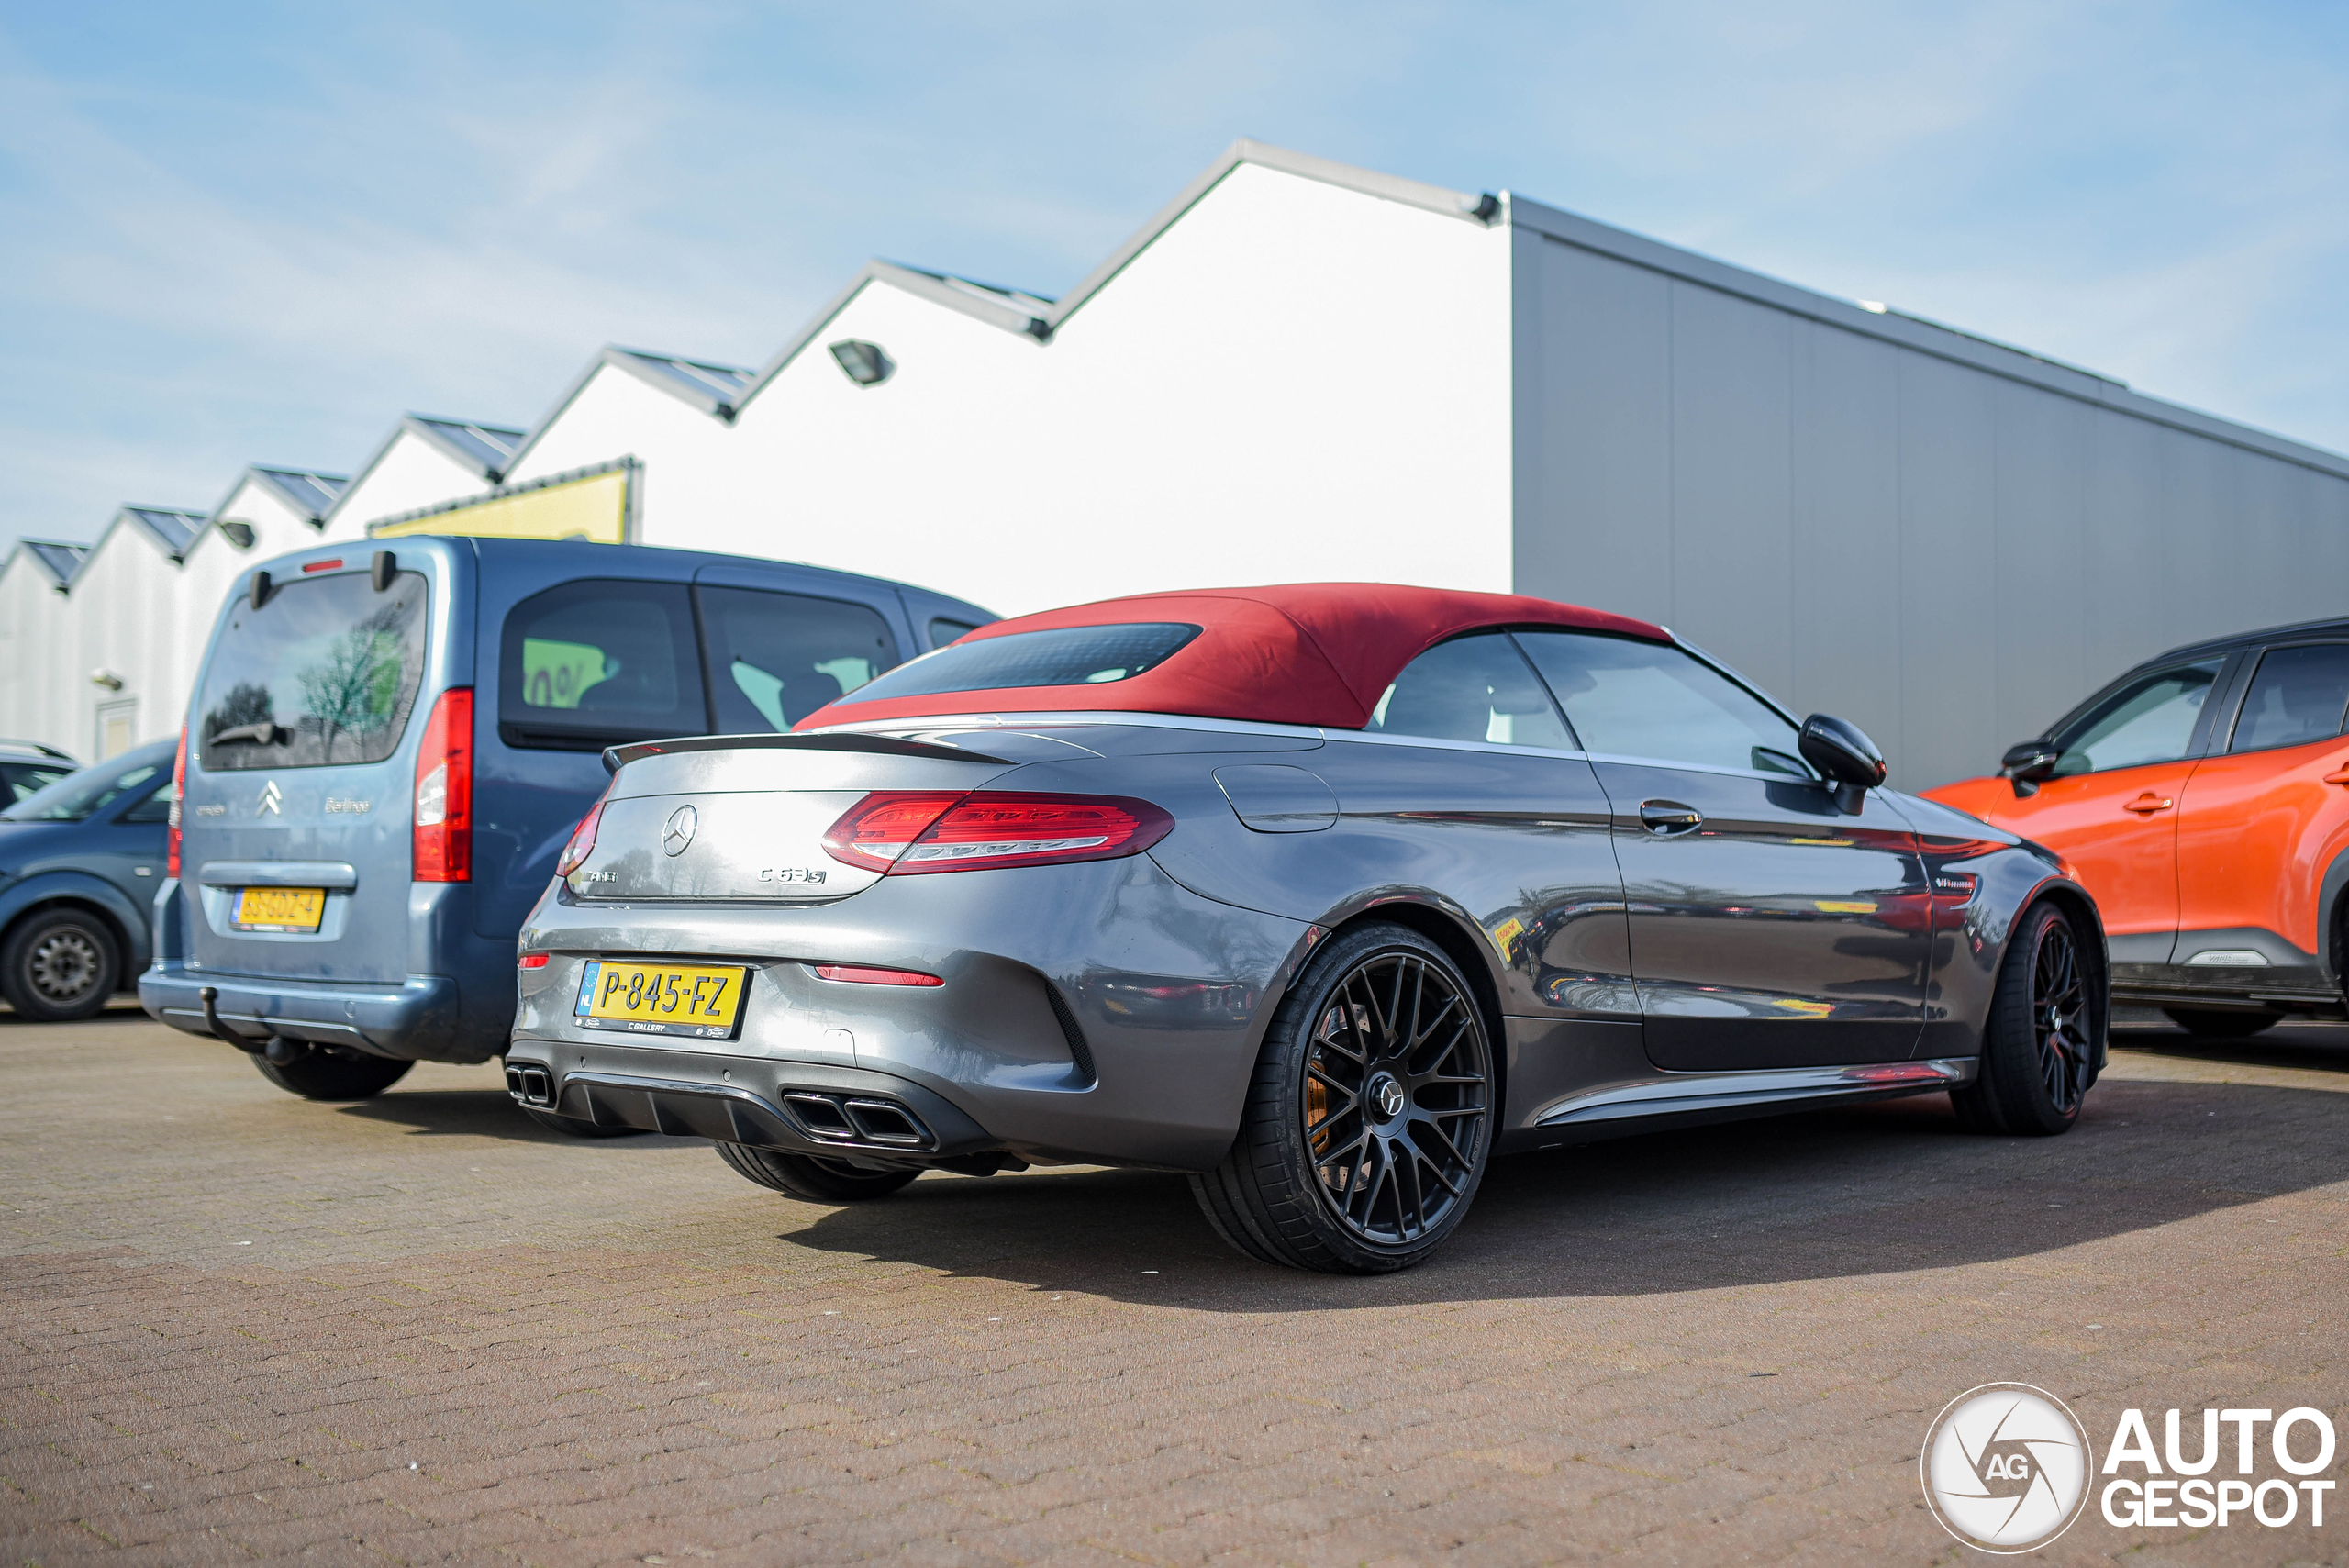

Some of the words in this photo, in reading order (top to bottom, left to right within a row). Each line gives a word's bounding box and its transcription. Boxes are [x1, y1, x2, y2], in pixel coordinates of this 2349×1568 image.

[325, 796, 371, 815] Berlingo
[581, 994, 590, 1006] NL
[600, 972, 728, 1016] P-845-FZ
